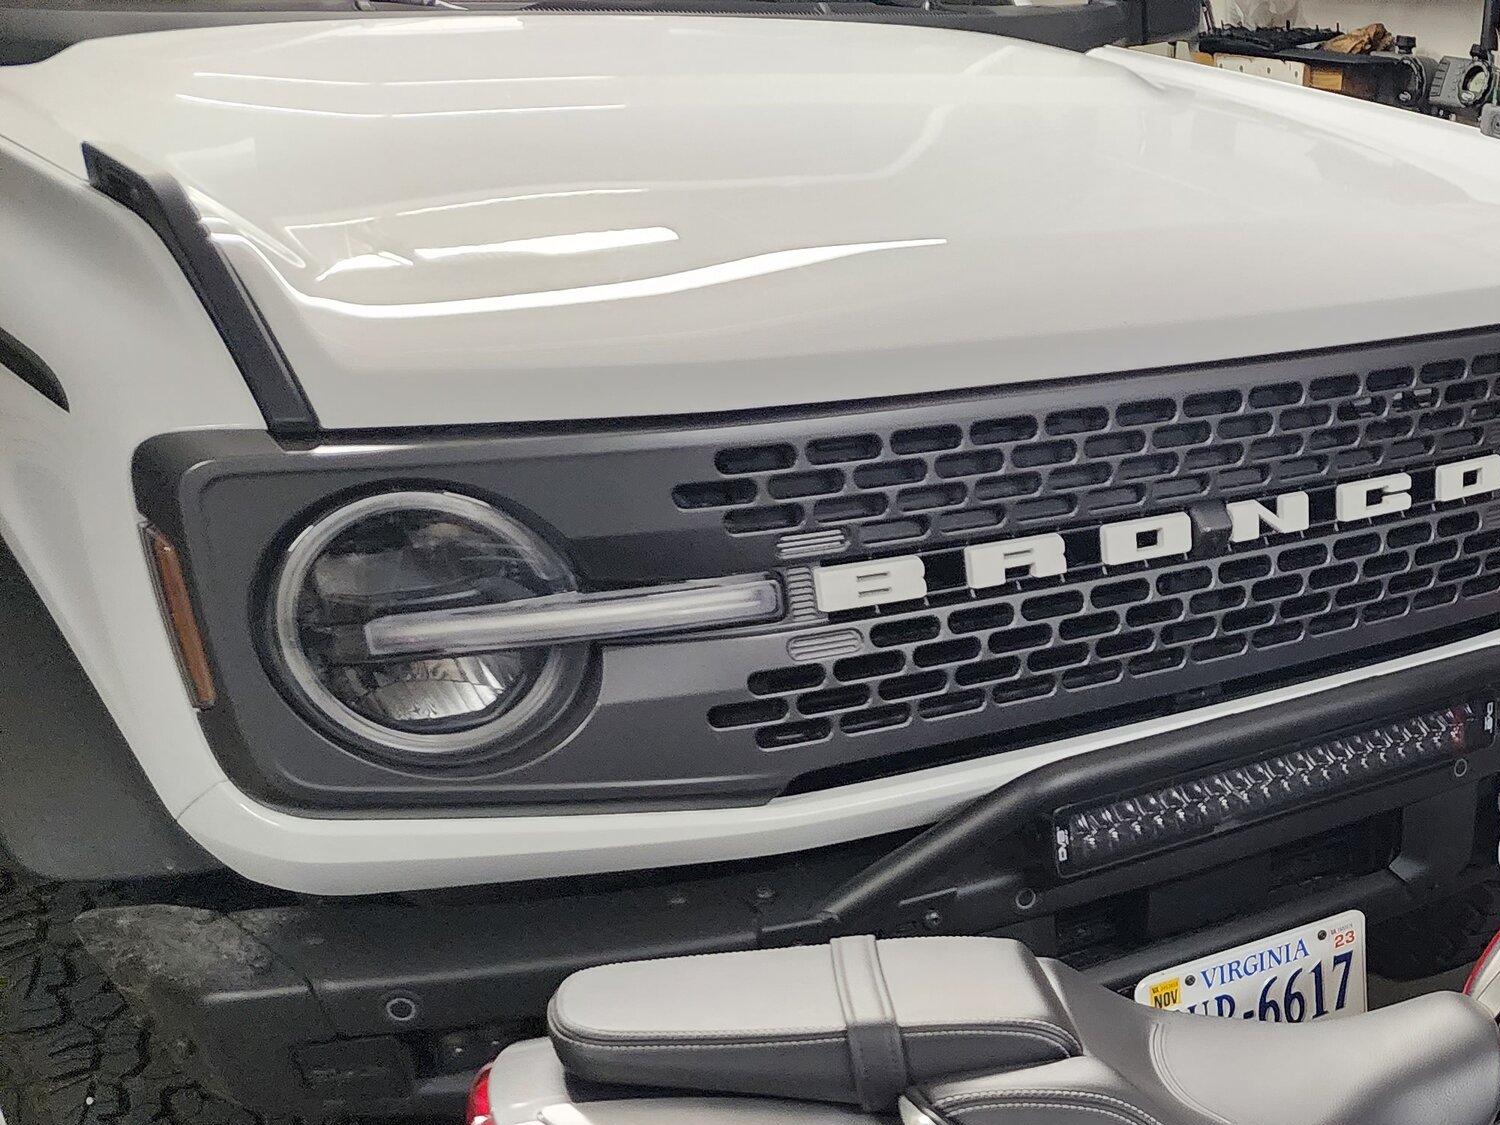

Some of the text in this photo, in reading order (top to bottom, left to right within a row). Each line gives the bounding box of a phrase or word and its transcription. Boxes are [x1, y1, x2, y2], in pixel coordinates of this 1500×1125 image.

[1334, 930, 1356, 948] 23
[1200, 938, 1310, 990] VIRGINIA
[1153, 989, 1179, 1009] NOV
